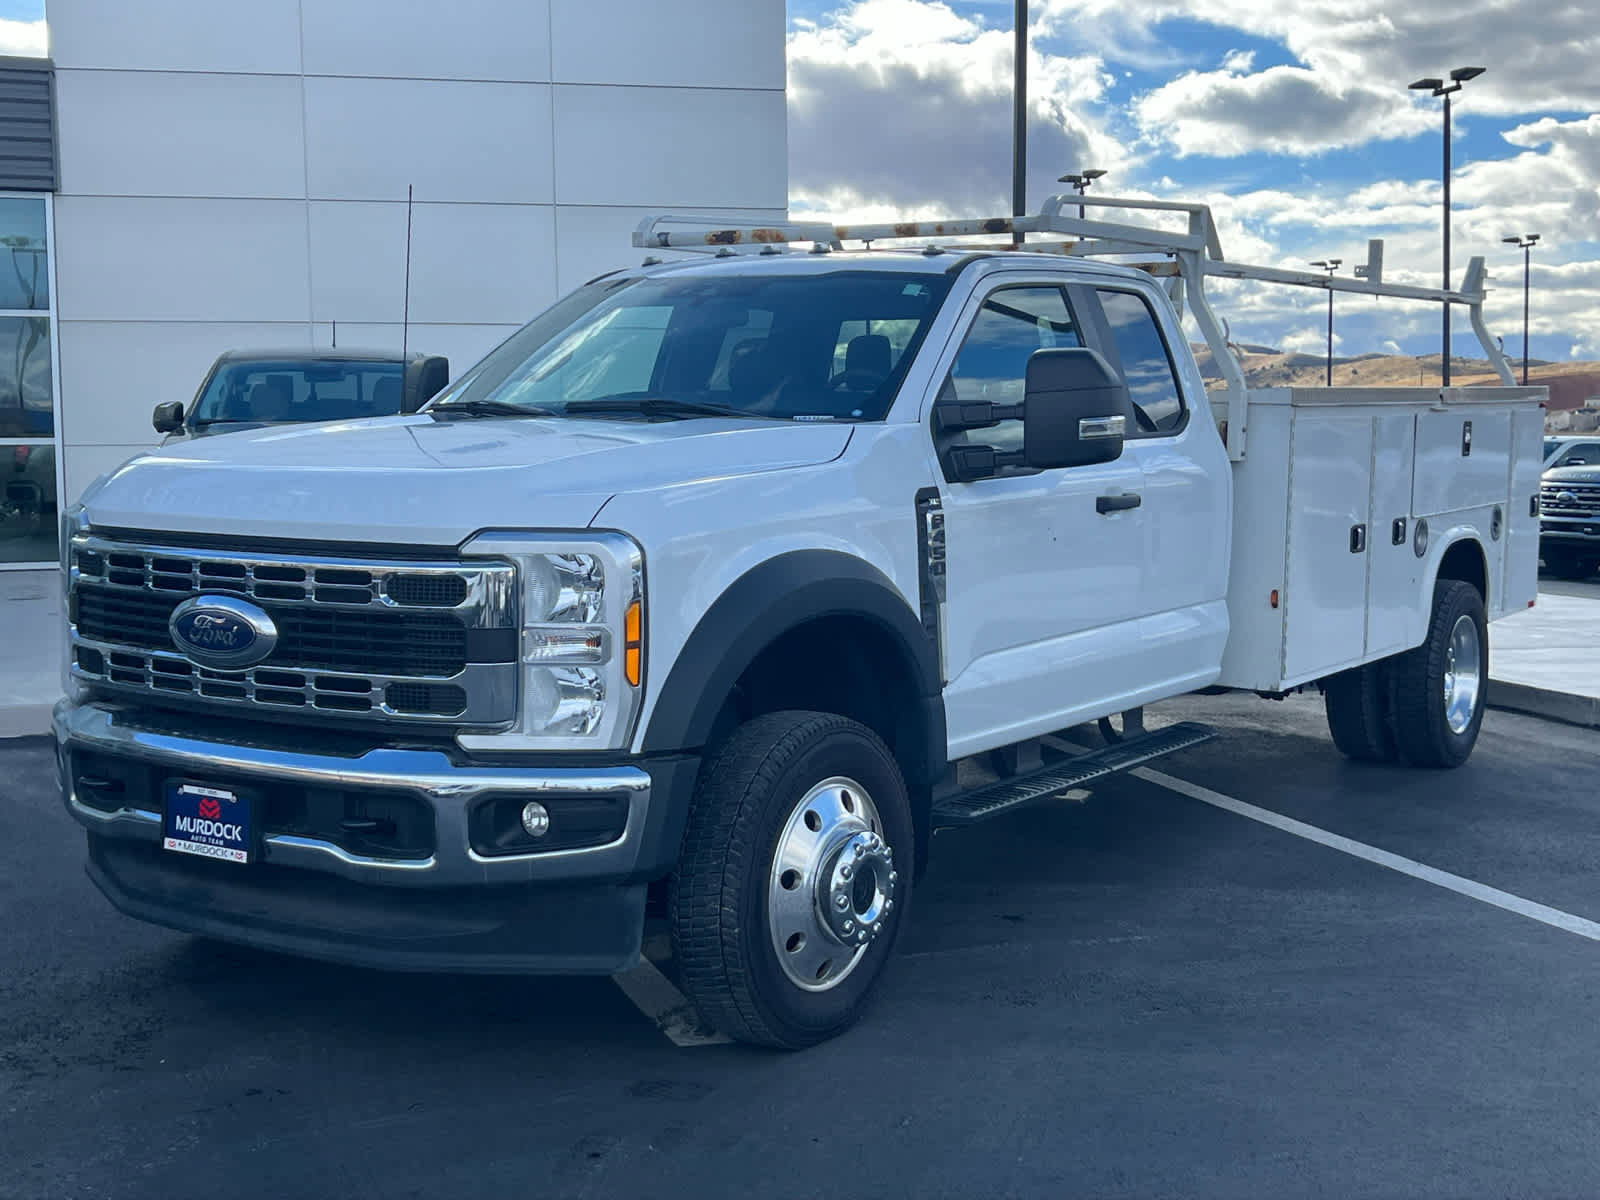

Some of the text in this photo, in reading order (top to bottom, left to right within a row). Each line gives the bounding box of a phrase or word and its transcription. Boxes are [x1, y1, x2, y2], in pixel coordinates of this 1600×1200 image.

[190, 614, 238, 646] Ford
[175, 815, 242, 841] MURDOCK
[183, 842, 229, 858] MURDOCK
[191, 834, 224, 846] AUTO TEAM
